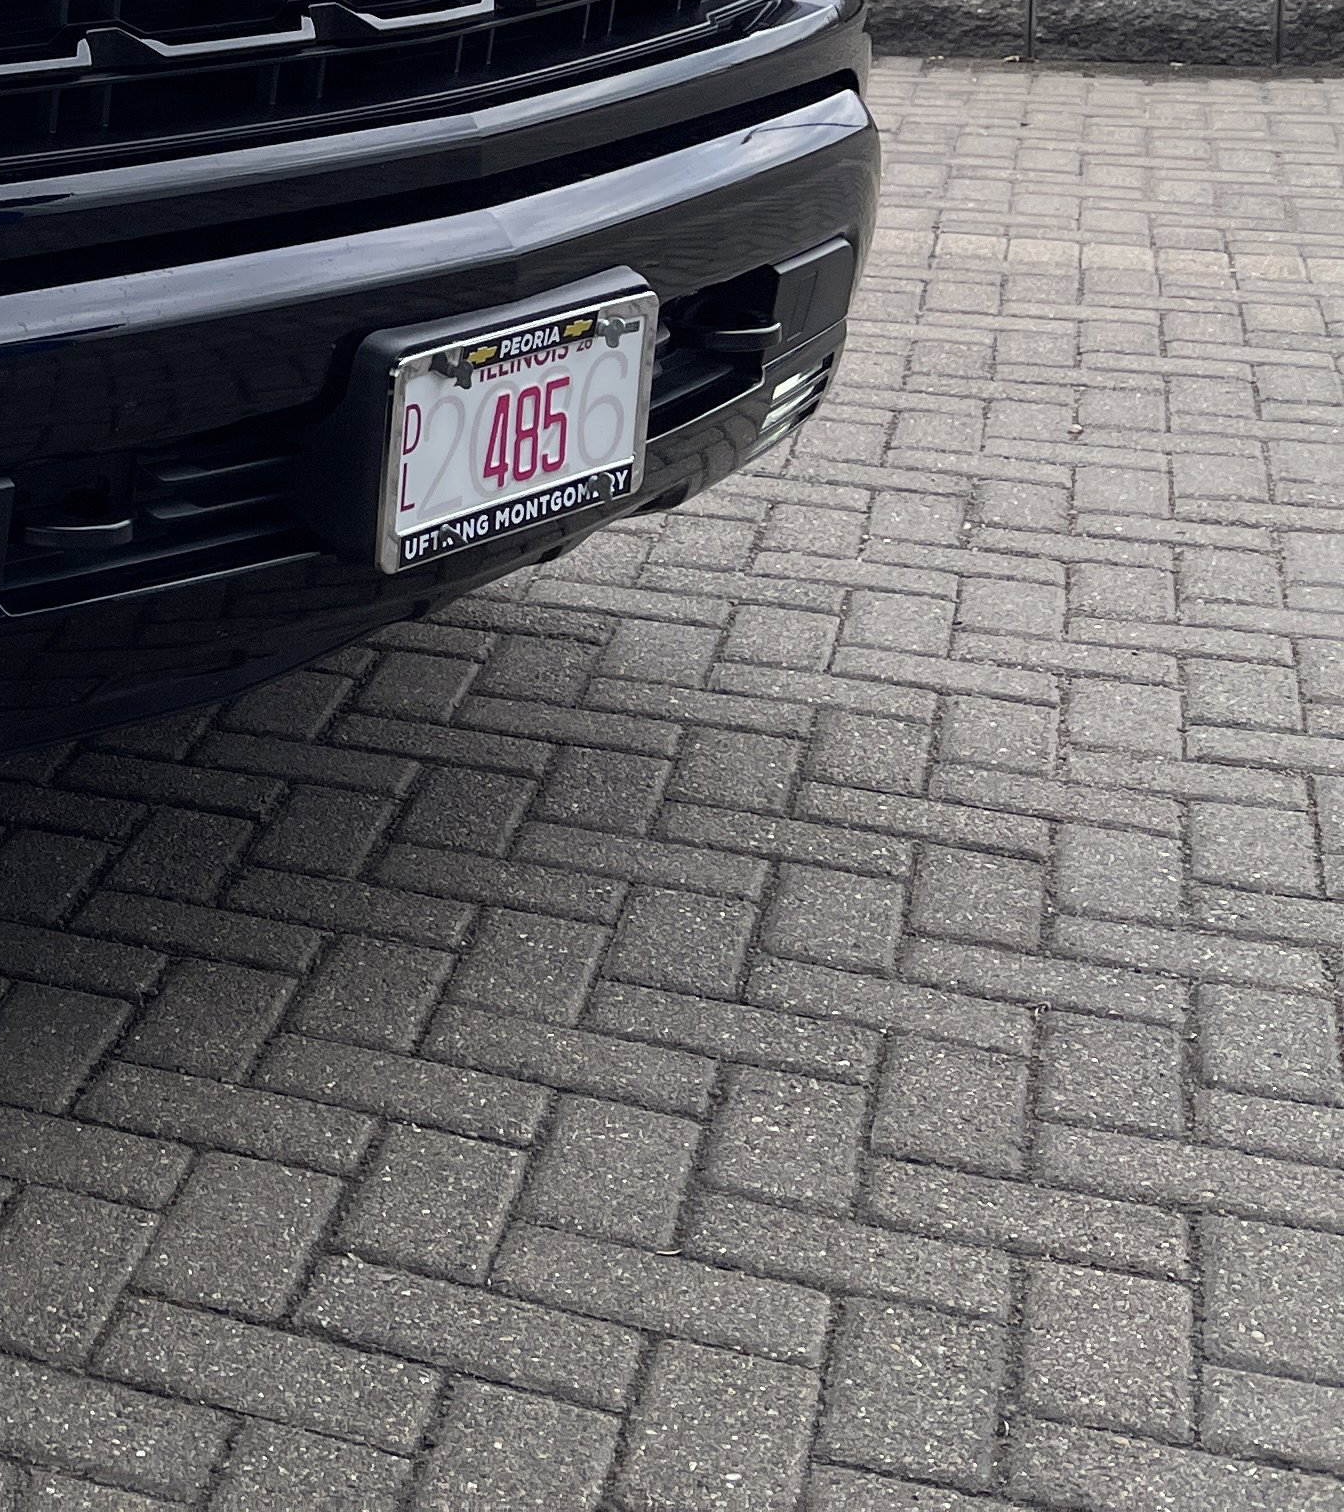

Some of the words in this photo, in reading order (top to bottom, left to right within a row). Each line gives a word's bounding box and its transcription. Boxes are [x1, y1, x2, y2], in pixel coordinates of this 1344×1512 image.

[499, 326, 561, 359] PEORIA
[483, 376, 570, 488] 485
[495, 469, 629, 531] MONTGOMRY
